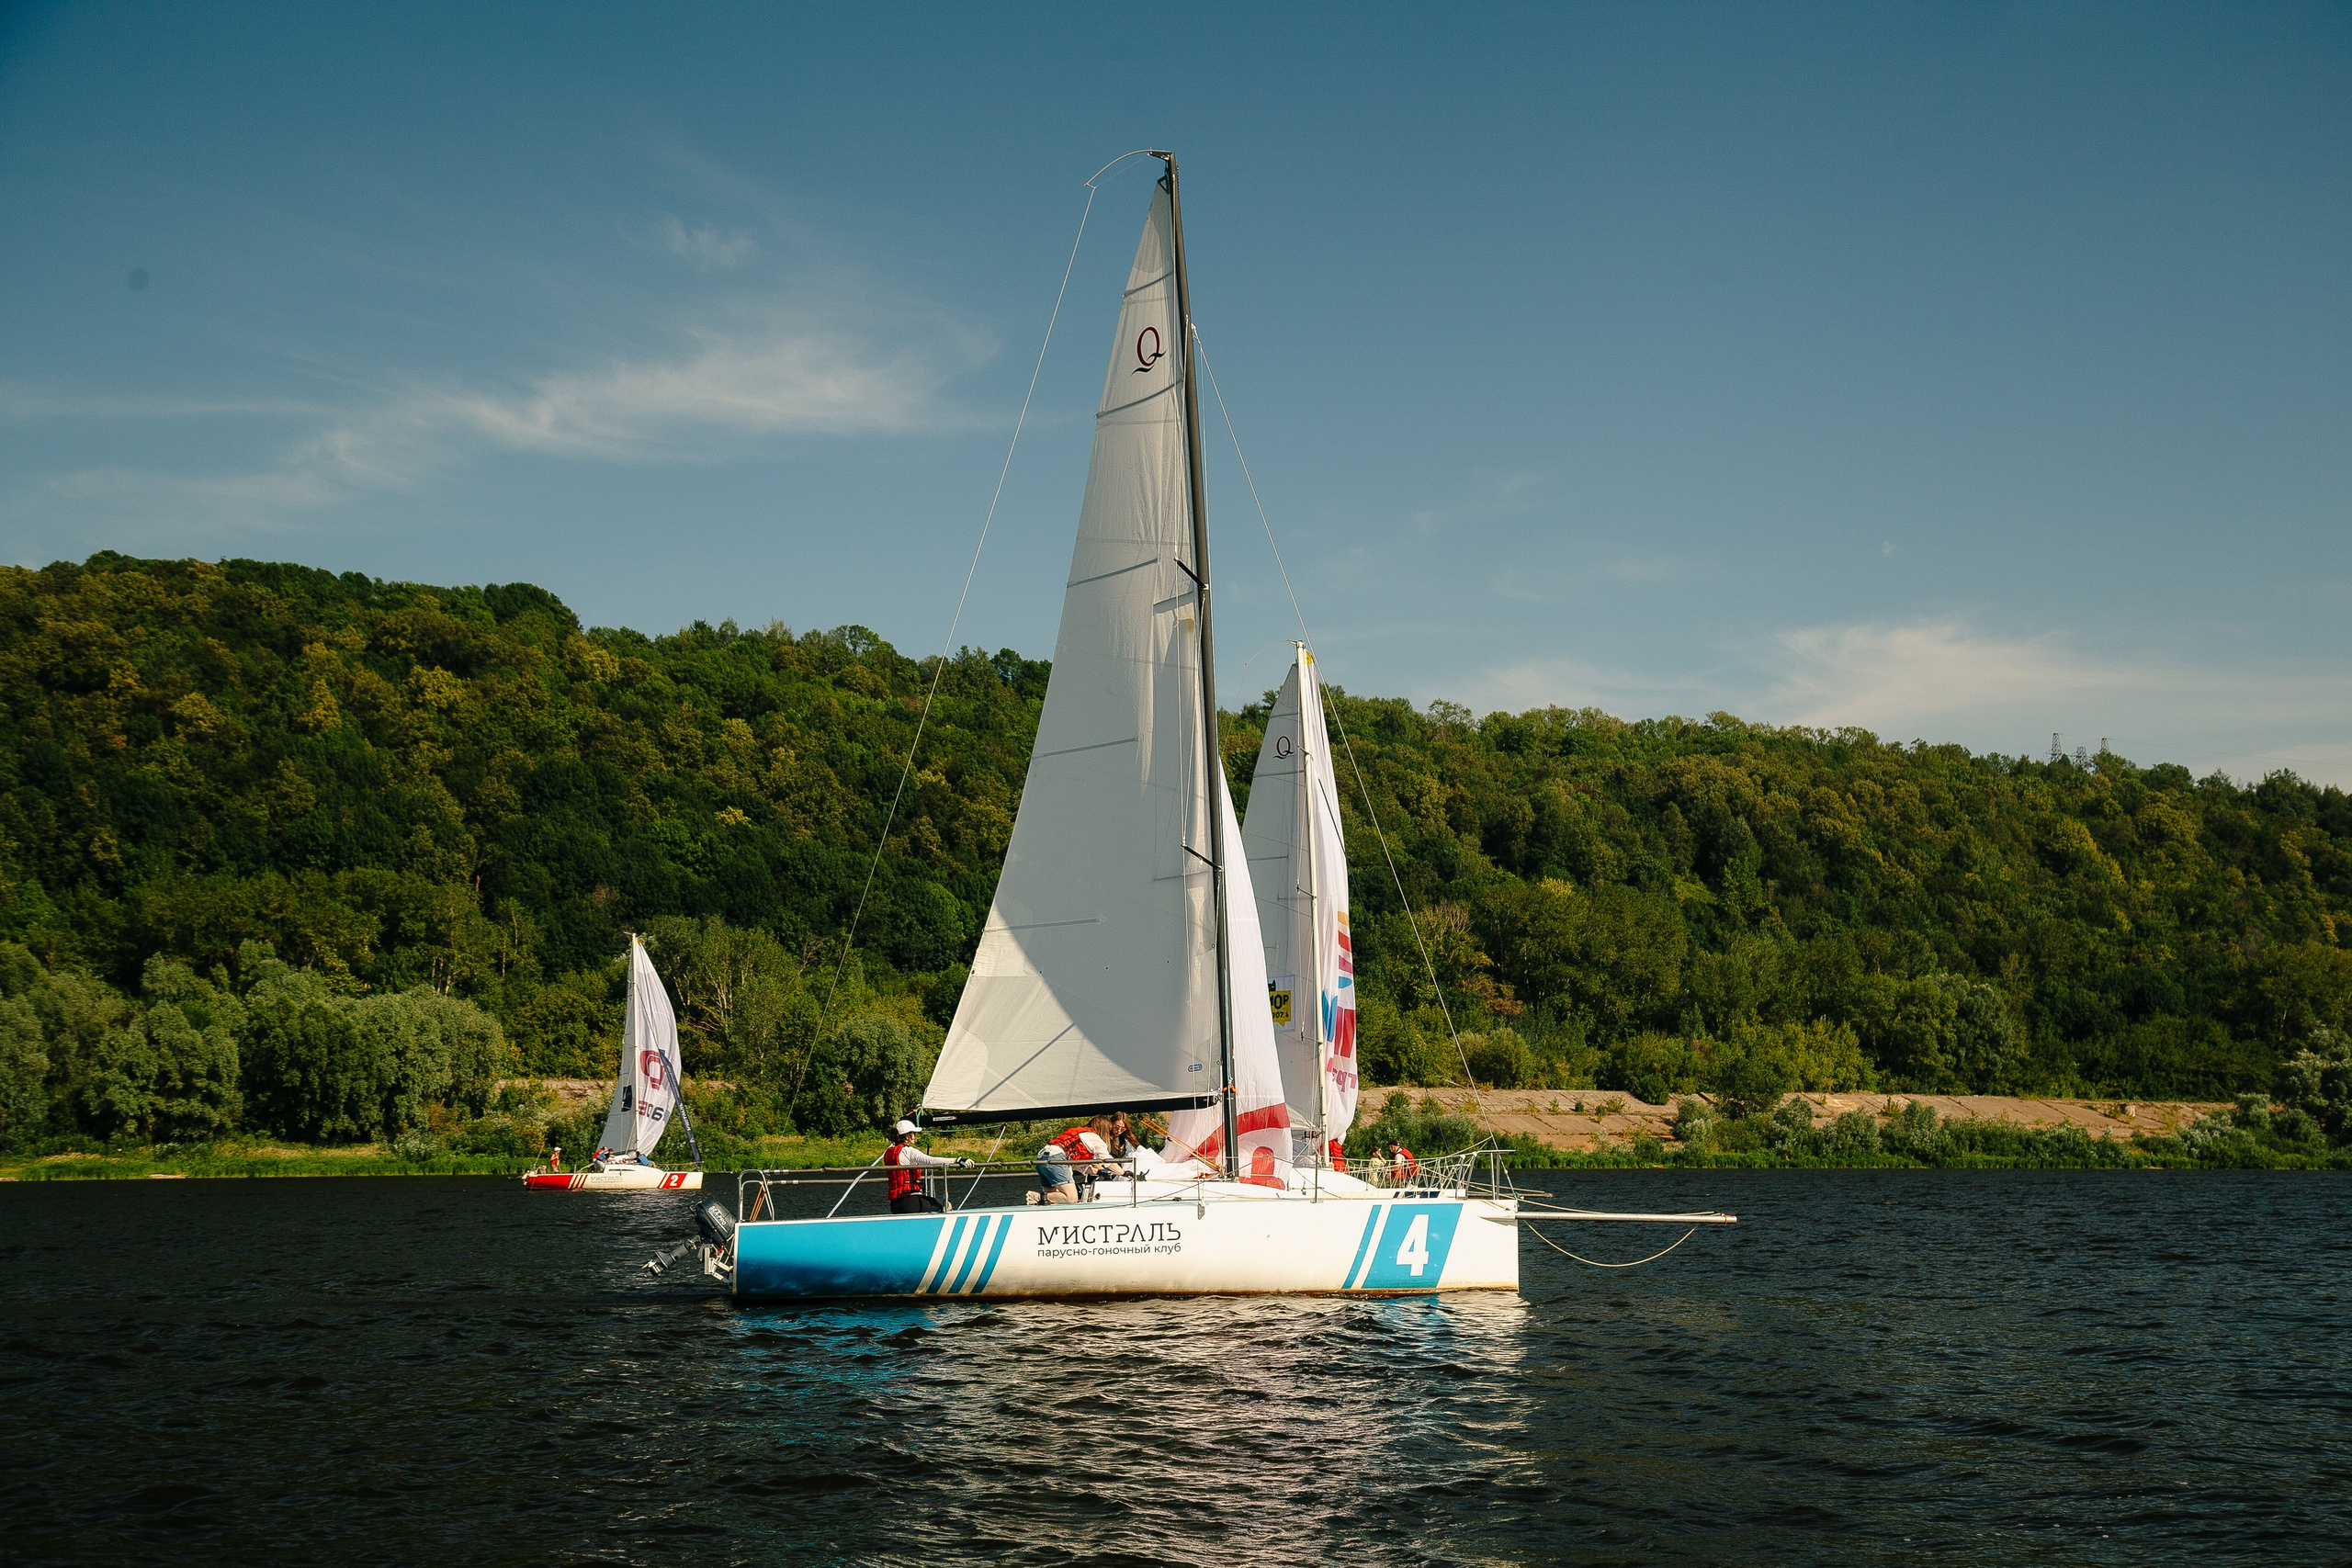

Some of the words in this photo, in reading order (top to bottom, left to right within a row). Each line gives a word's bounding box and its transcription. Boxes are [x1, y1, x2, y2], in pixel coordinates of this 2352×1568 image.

[669, 1174, 679, 1187] 2
[1037, 1223, 1182, 1246] МИСТРАЛЬ
[1037, 1244, 1151, 1259] парусно-гоночный
[1154, 1242, 1182, 1256] клуб
[1396, 1213, 1430, 1277] 4
